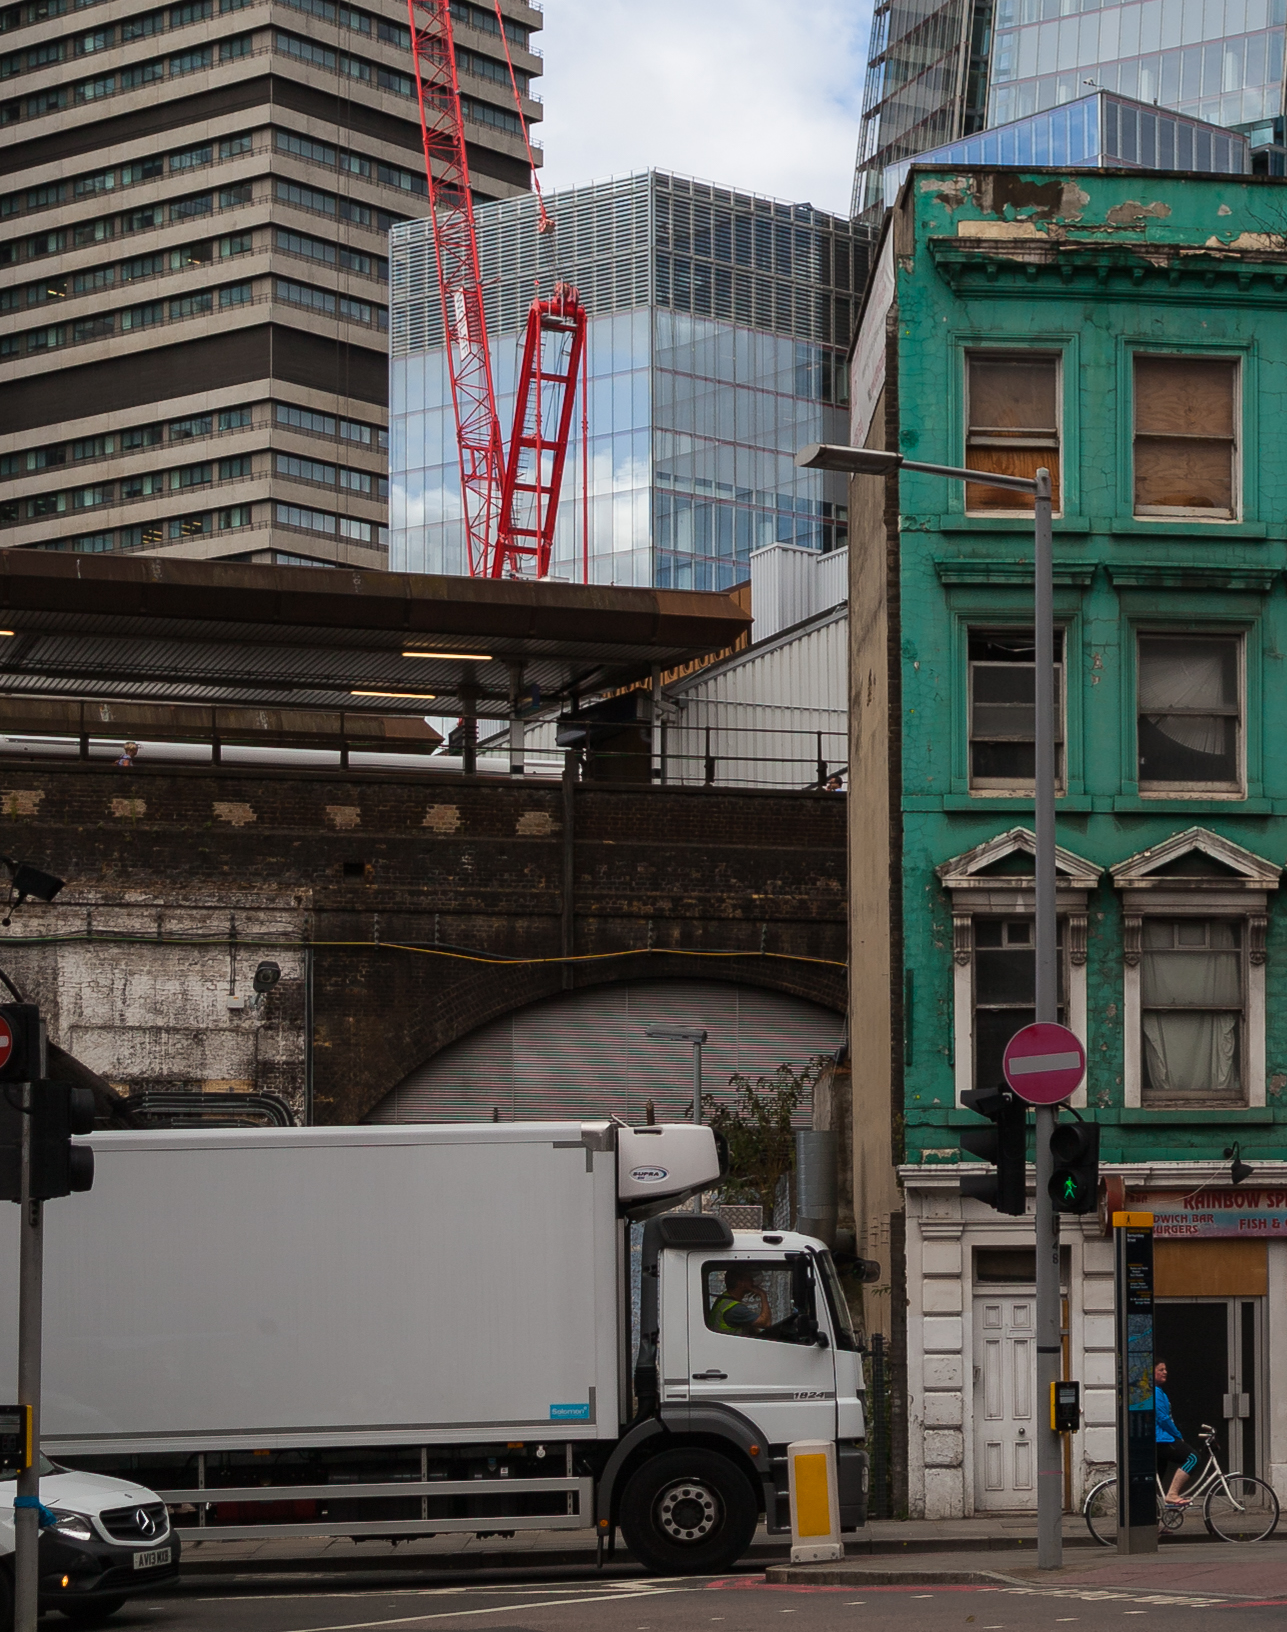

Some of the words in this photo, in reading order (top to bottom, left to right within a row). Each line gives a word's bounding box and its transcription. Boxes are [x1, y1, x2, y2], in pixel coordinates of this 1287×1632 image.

[1183, 1192, 1260, 1210] RAINBOW
[1192, 1214, 1214, 1224] BAR
[1239, 1218, 1267, 1230] FISH
[1272, 1219, 1281, 1229] &
